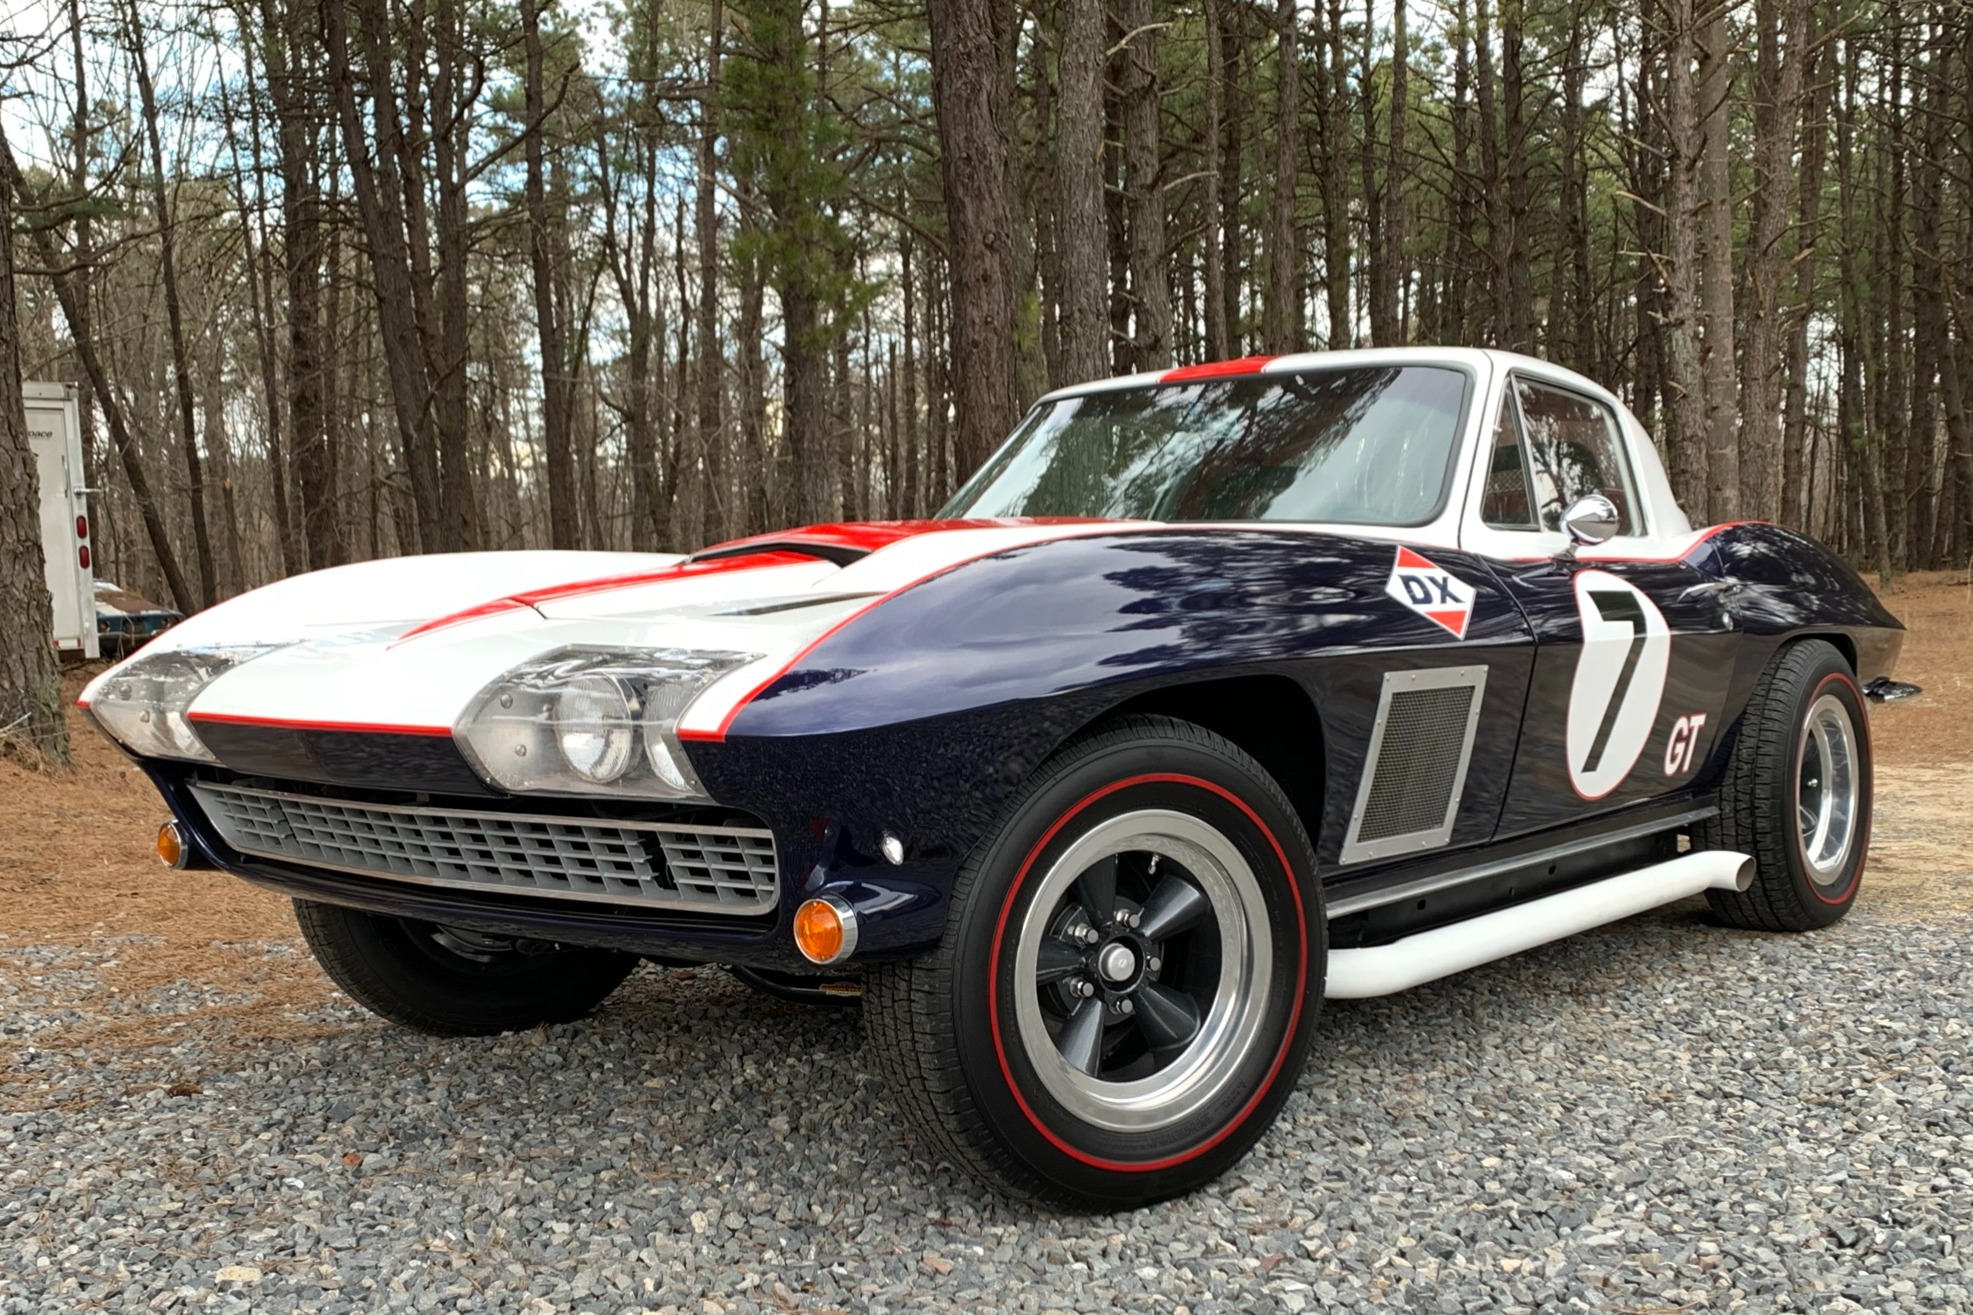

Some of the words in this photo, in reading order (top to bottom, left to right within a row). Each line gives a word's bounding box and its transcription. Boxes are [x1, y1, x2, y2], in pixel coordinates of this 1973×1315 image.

[1397, 574, 1466, 605] DX
[1581, 590, 1648, 774] 7
[1664, 712, 1707, 776] GT
